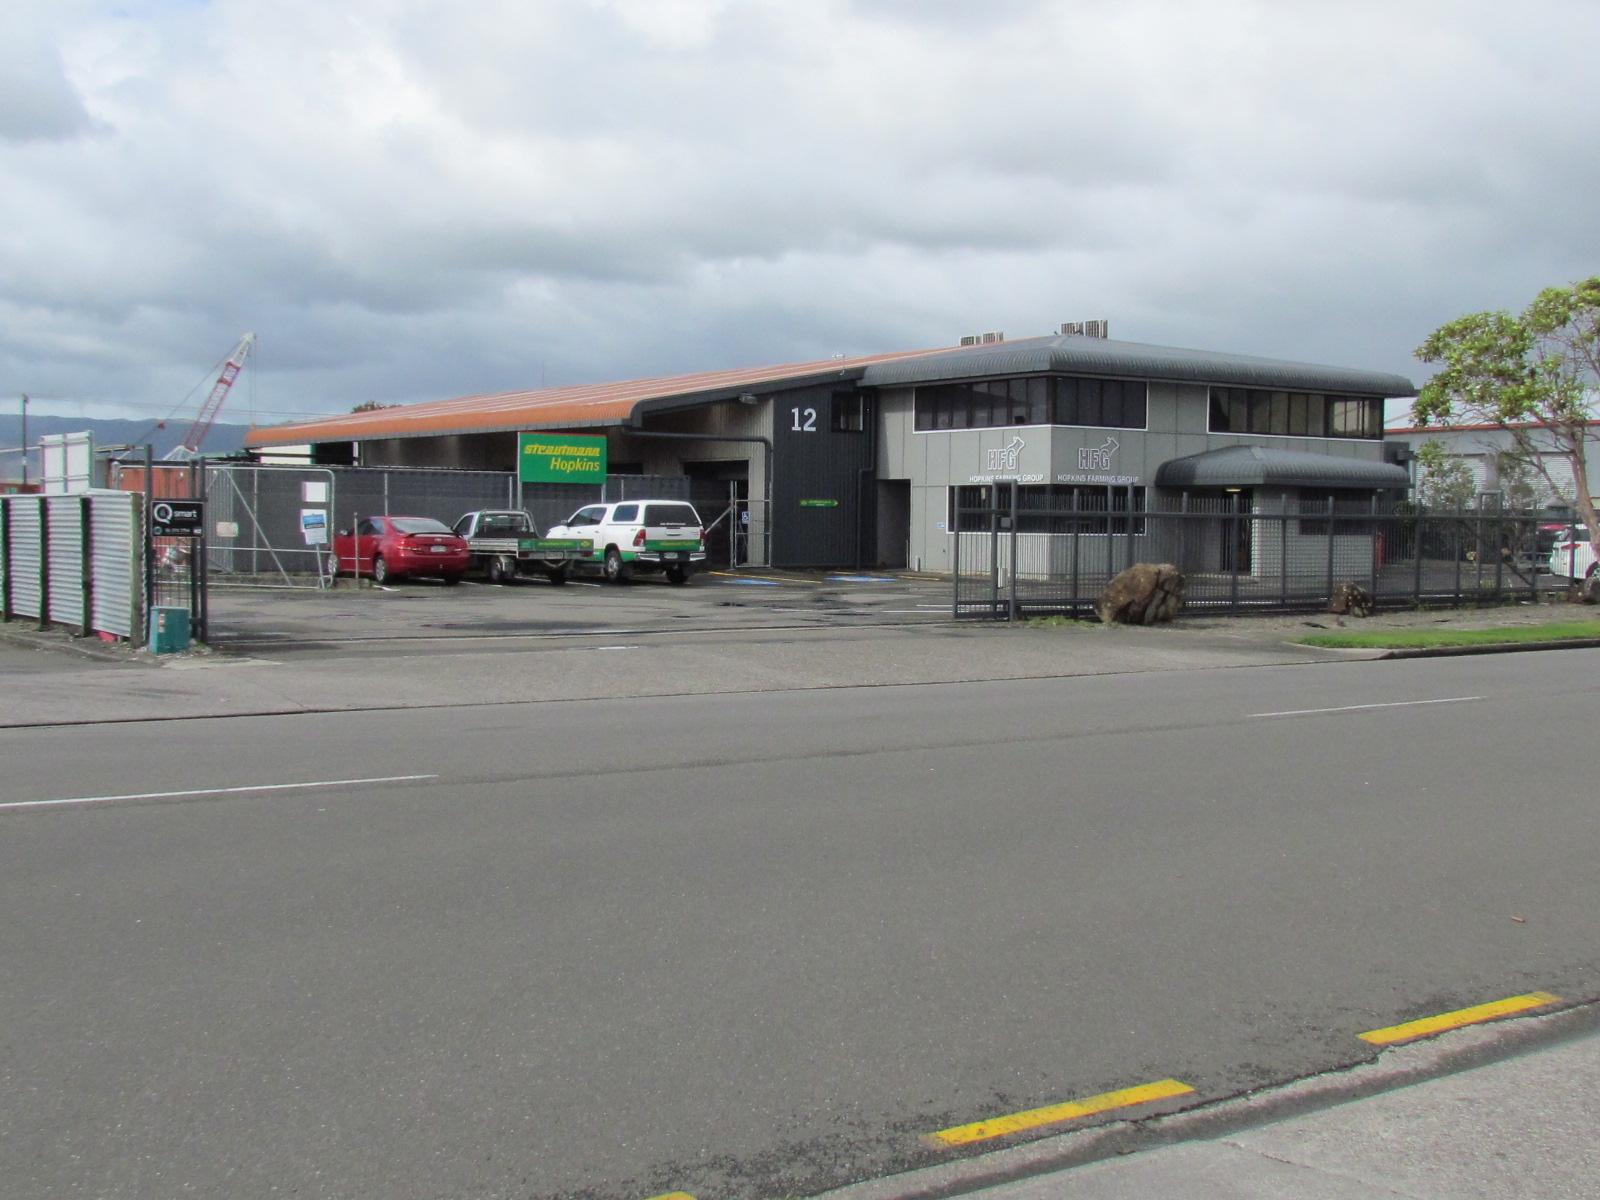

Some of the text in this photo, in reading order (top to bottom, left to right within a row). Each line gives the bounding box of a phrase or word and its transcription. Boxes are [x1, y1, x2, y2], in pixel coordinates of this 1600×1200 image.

[791, 407, 817, 432] 12
[550, 457, 600, 474] Hopkins
[987, 448, 1017, 470] HFG
[1078, 447, 1110, 471] HFG
[969, 474, 994, 483] HOPKINS
[1022, 473, 1044, 483] GROUP
[1057, 474, 1140, 484] HOPKINS FARMING GROUP
[173, 510, 197, 518] smart
